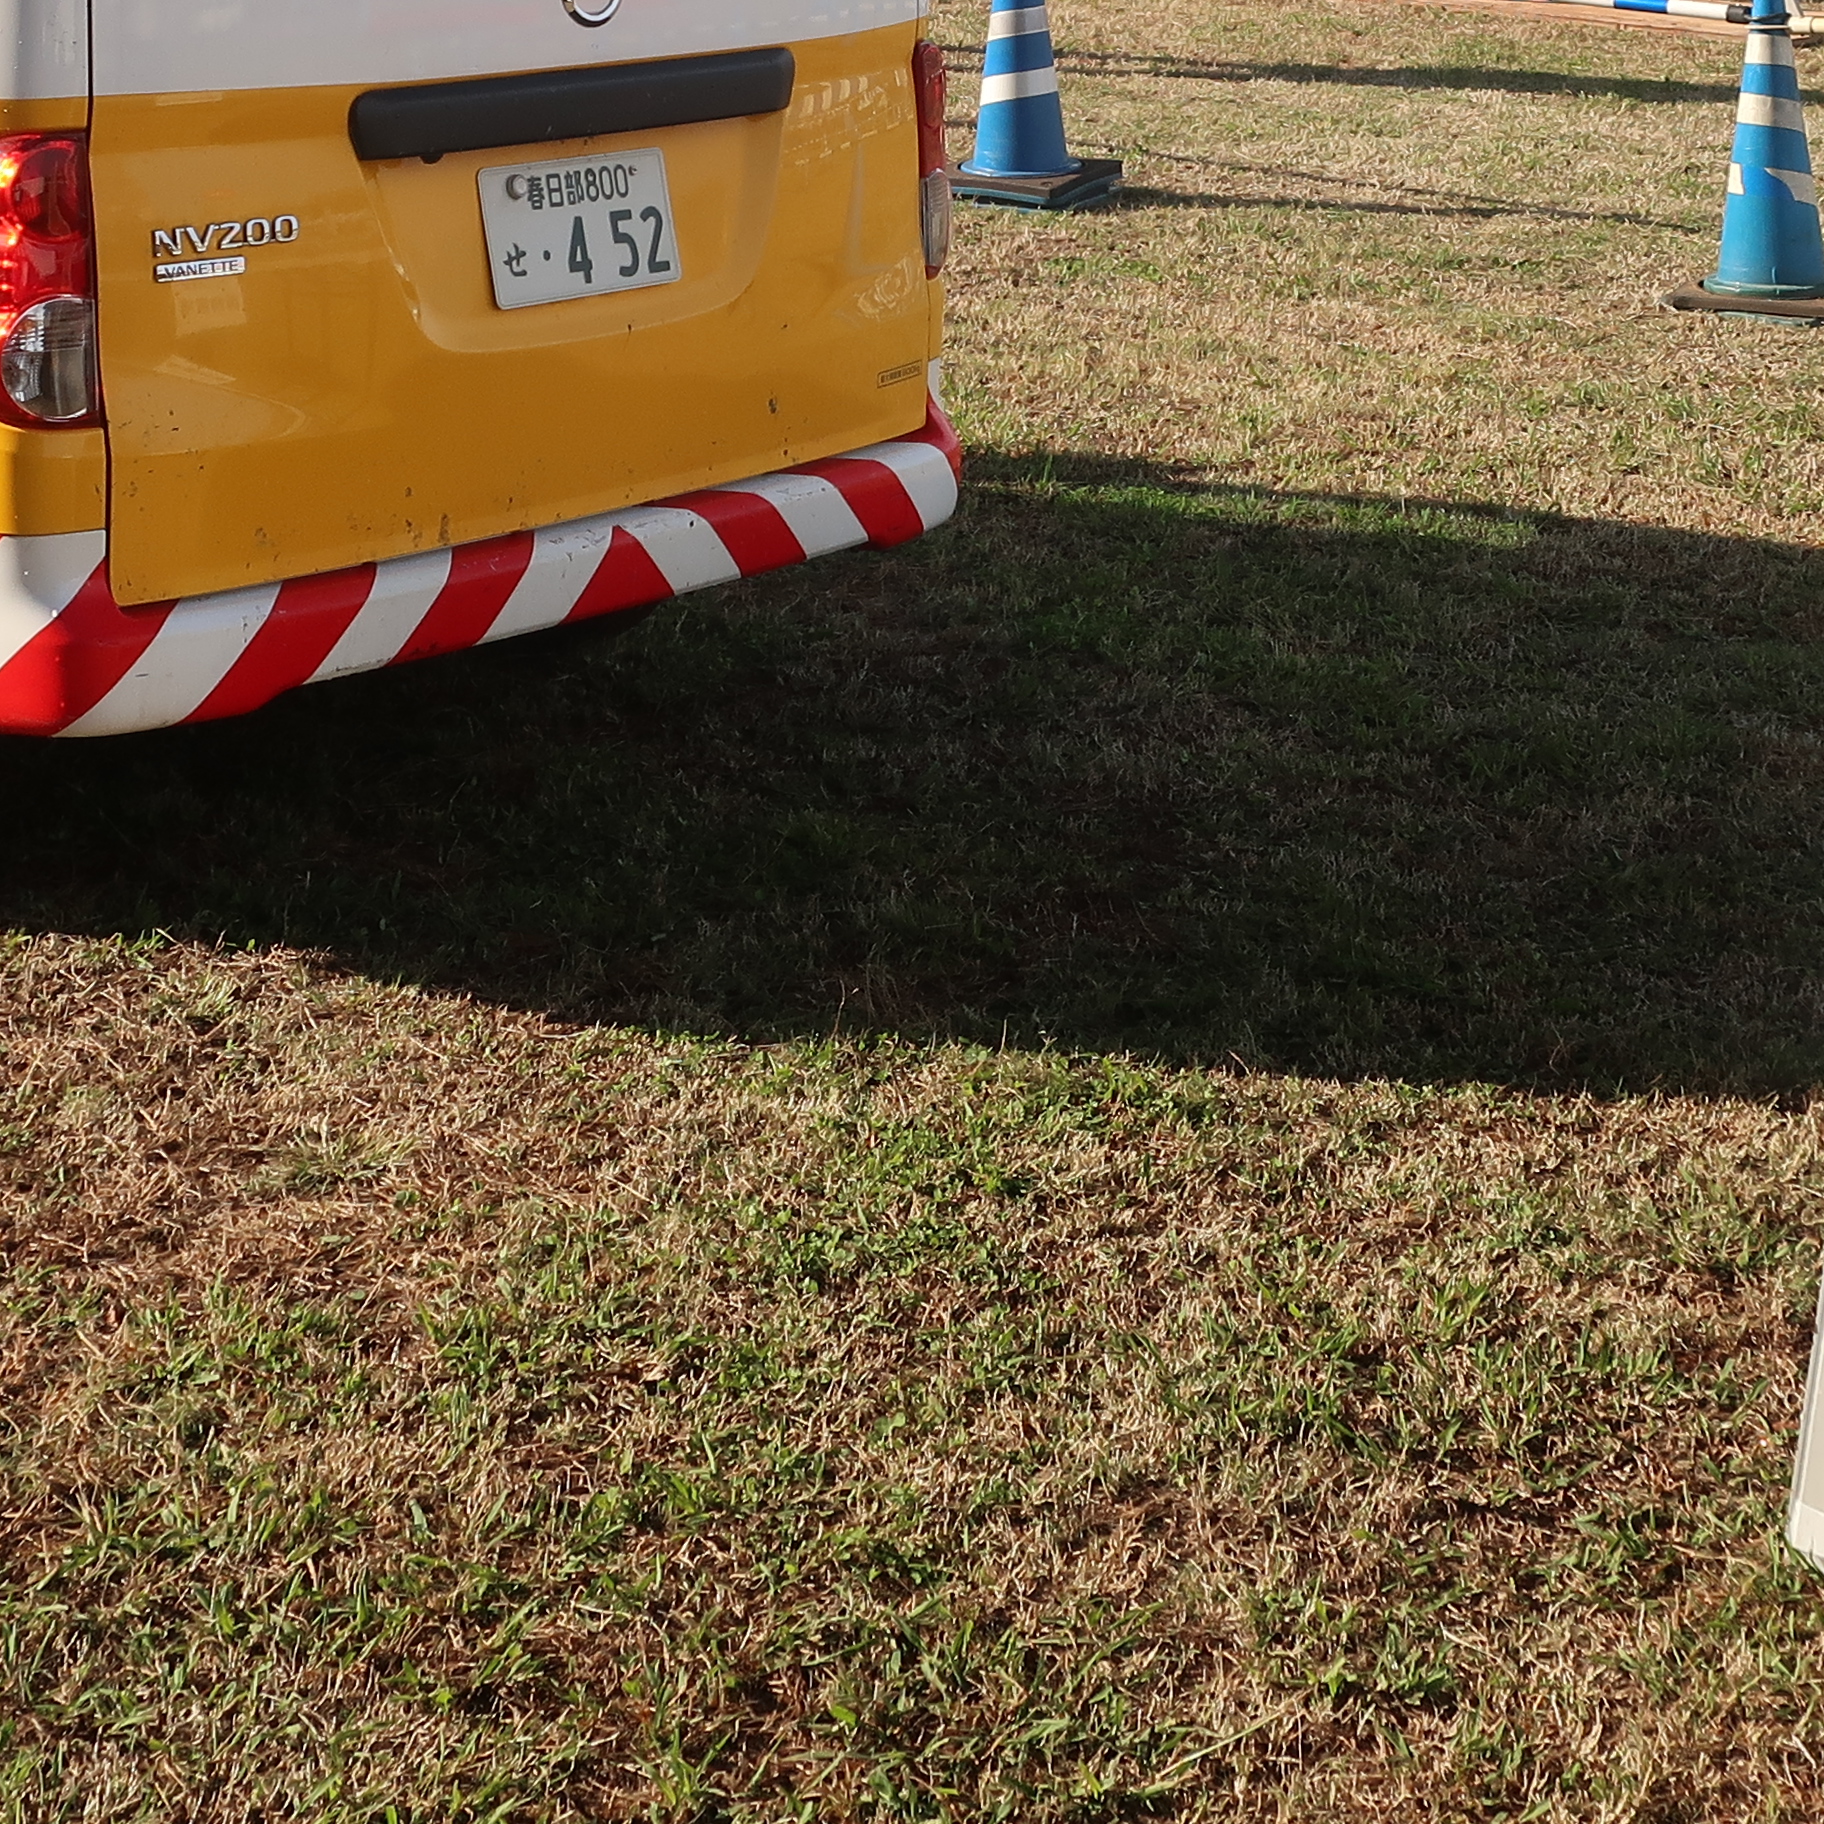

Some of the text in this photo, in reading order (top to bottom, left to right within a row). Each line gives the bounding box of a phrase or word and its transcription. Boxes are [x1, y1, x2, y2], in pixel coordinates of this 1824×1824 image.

[152, 214, 299, 257] NV200
[164, 259, 239, 278] VANETTE
[503, 242, 529, 278] せ
